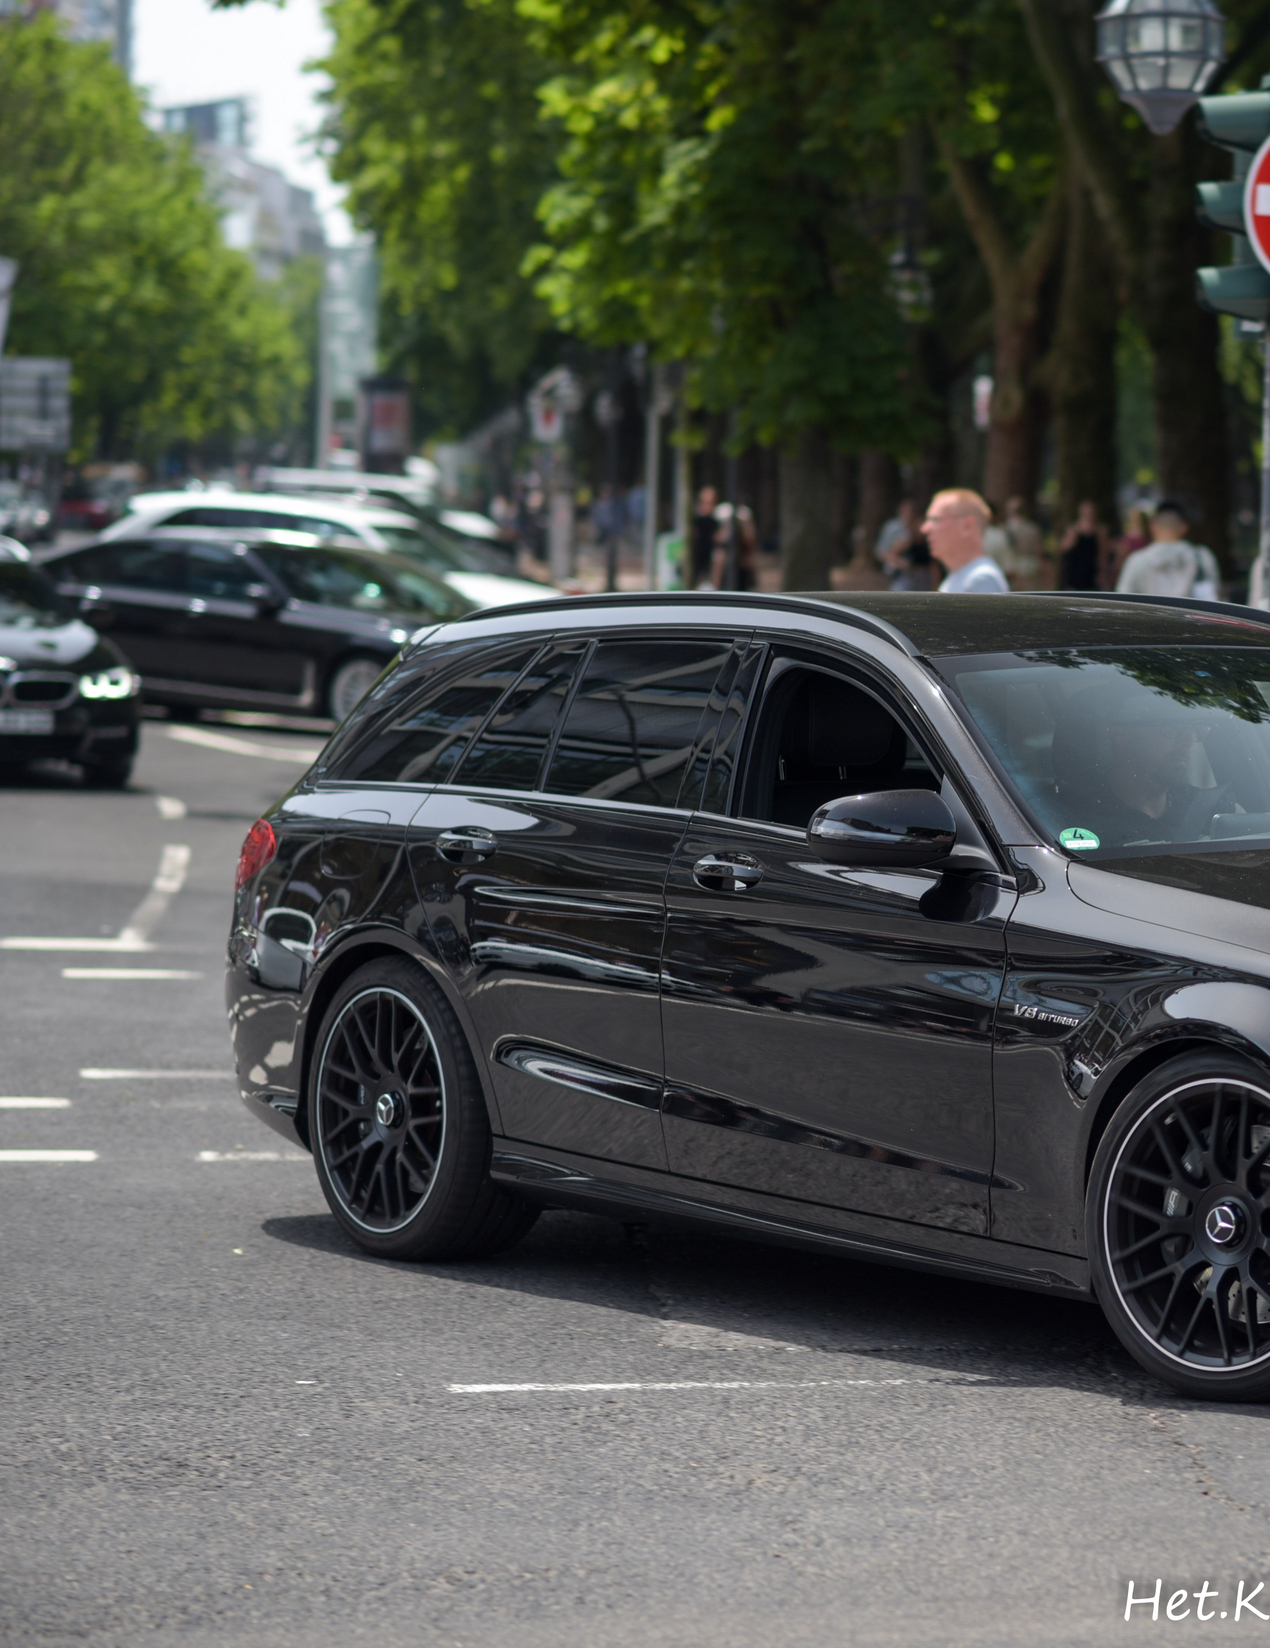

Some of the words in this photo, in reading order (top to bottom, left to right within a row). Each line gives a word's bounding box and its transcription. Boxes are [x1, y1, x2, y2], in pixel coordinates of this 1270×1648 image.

[1072, 829, 1085, 840] 4
[1014, 1004, 1038, 1019] V8
[1037, 1012, 1079, 1027] BITURBO
